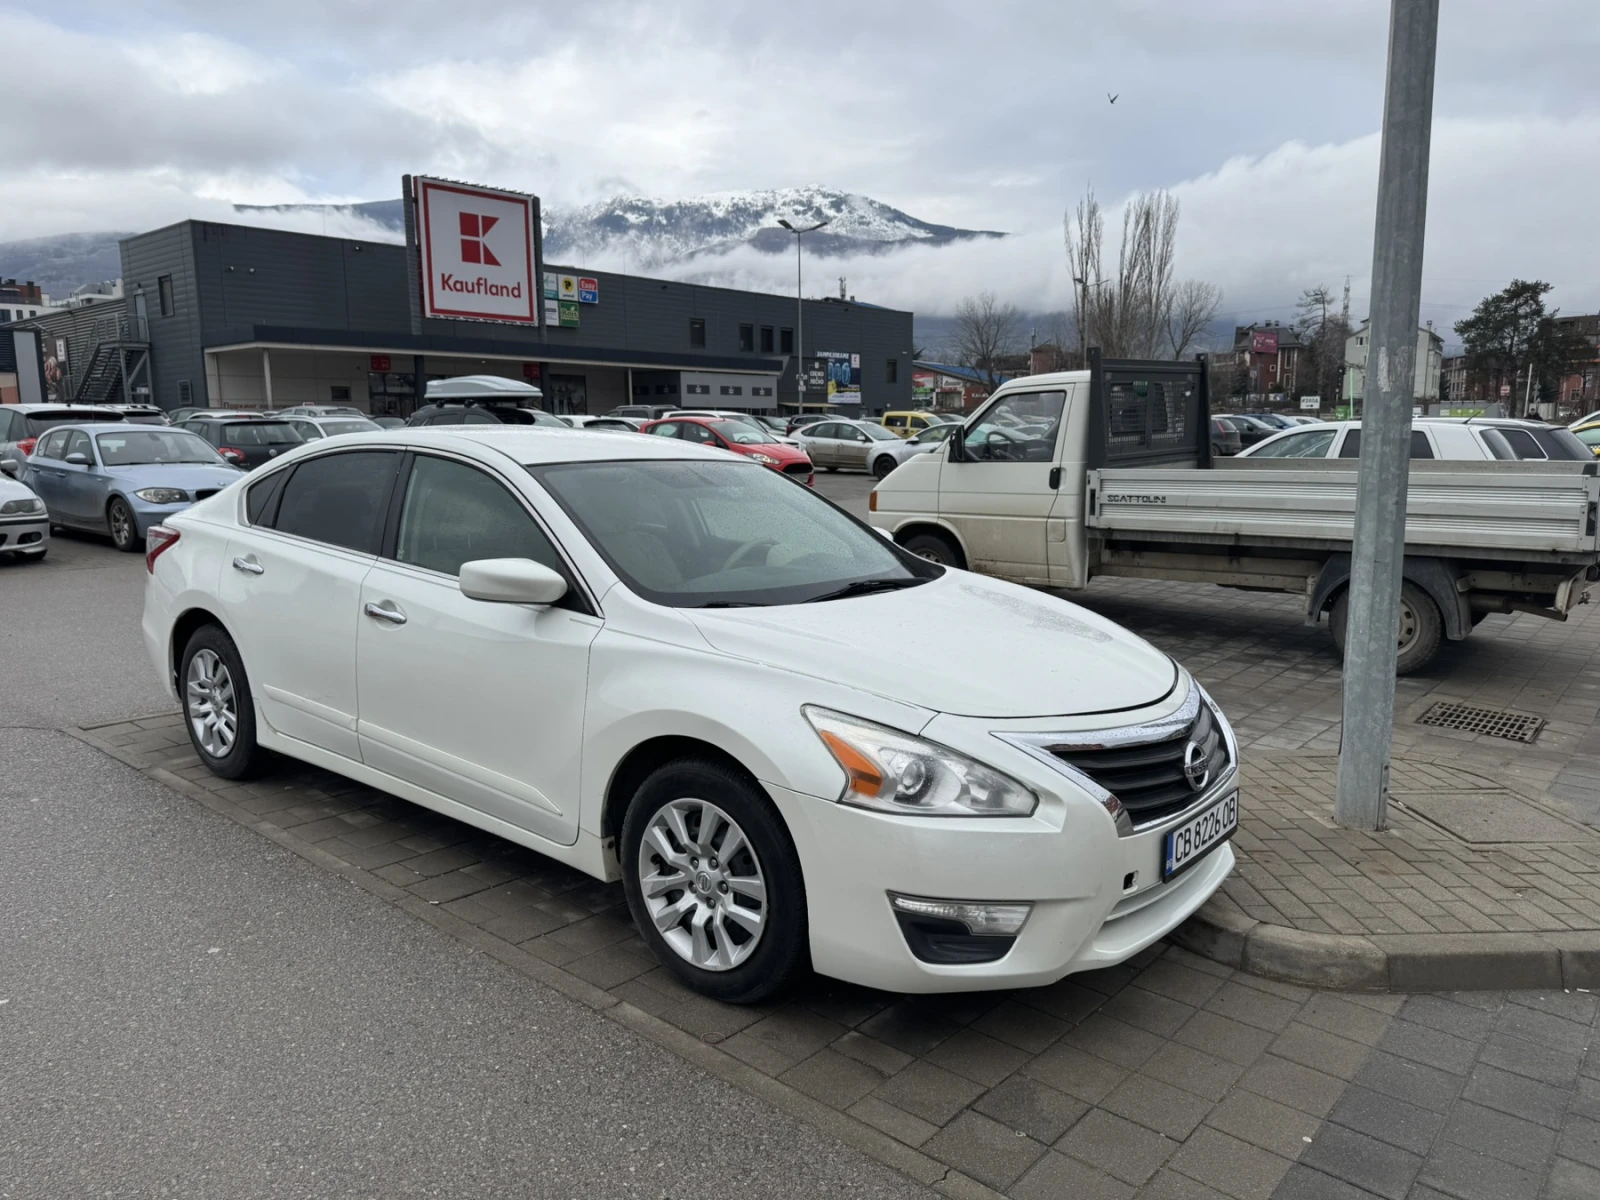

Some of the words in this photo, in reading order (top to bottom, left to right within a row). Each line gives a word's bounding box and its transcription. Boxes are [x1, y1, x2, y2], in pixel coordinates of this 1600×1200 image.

[441, 273, 521, 298] Kaufland
[581, 280, 596, 290] Easy
[581, 291, 593, 301] Pay
[1107, 494, 1167, 504] SCATTOLINI
[1175, 827, 1192, 863] CB
[1193, 806, 1221, 851] 8226
